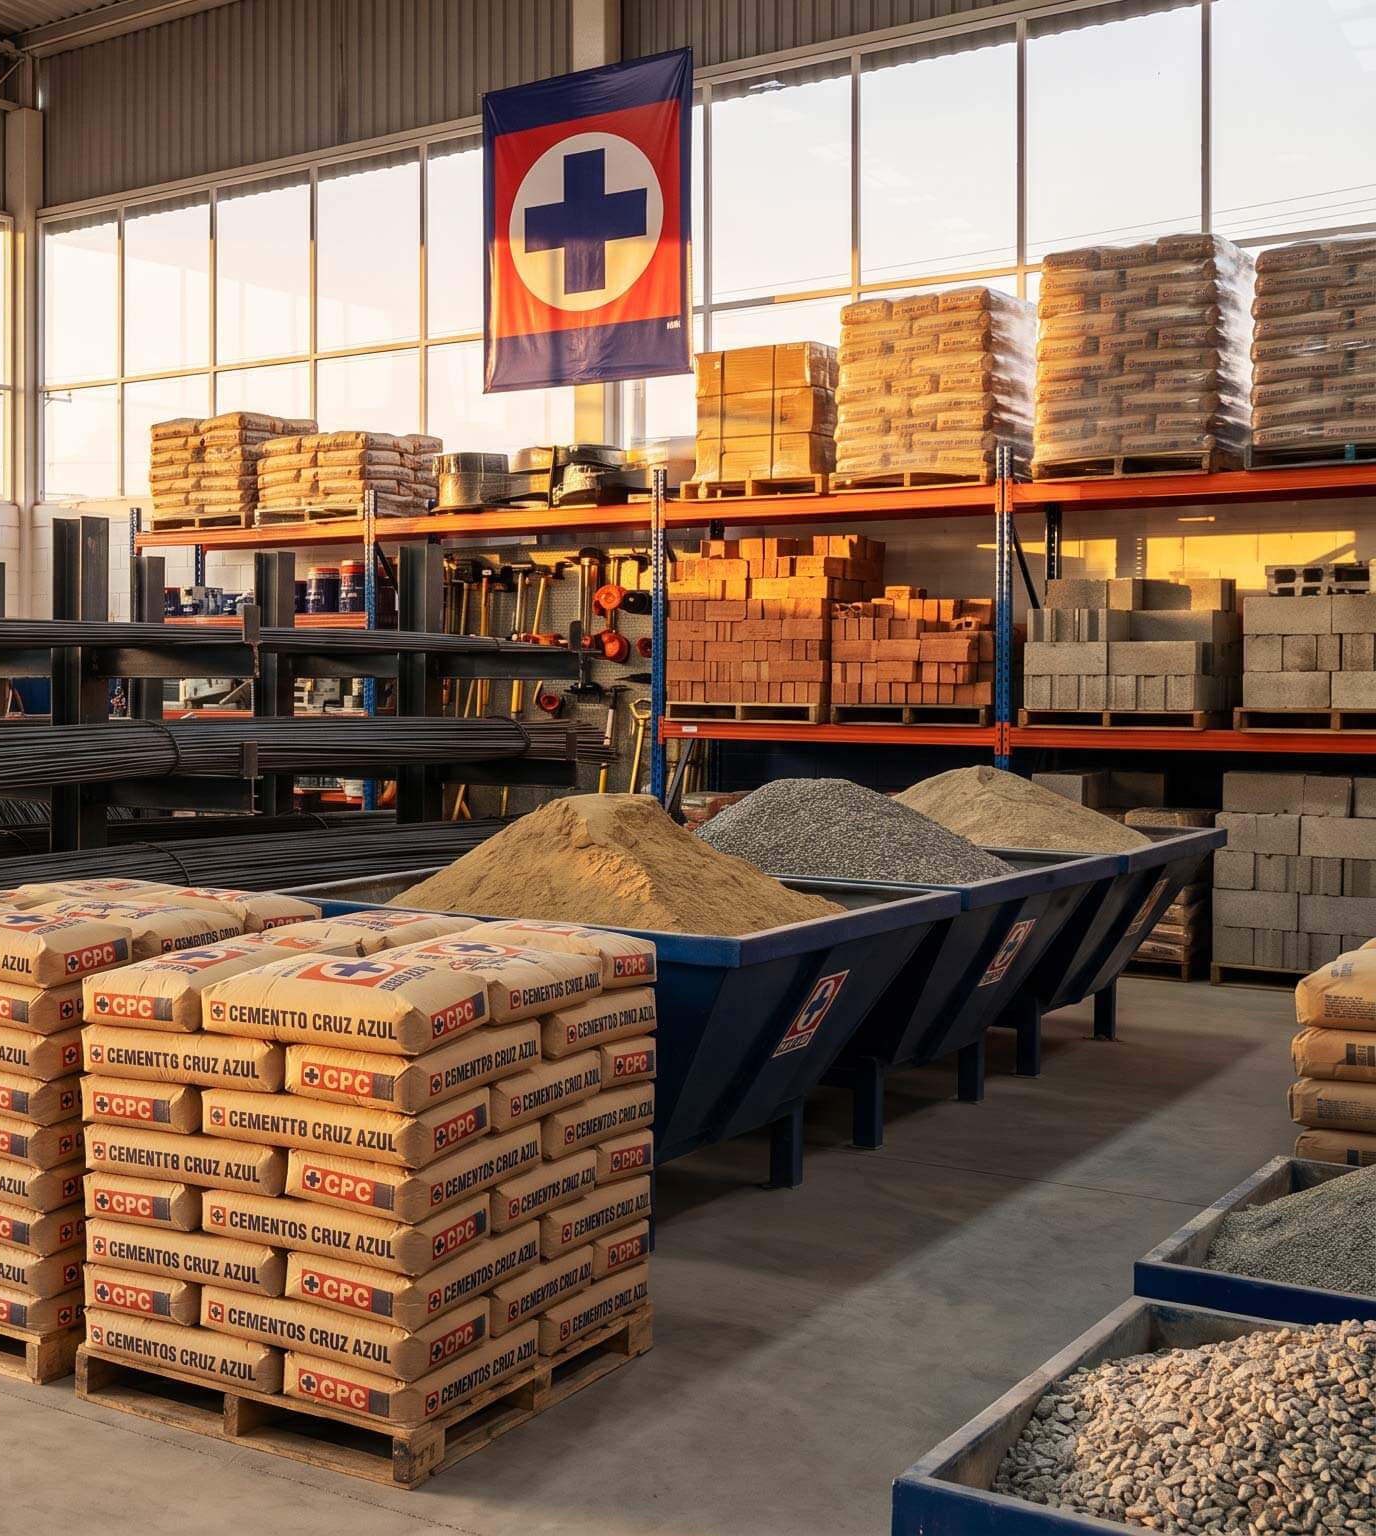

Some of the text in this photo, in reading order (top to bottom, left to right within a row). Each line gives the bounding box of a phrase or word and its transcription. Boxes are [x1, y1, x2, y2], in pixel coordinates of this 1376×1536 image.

[2, 955, 32, 973] AZUL
[82, 946, 114, 968] CPC
[625, 956, 646, 974] CPC
[112, 997, 153, 1017] CPC
[446, 1002, 474, 1028] CPC
[312, 1014, 352, 1034] CRUZ
[357, 1019, 397, 1040] AZUL
[183, 1054, 219, 1074] CRUZ
[222, 1059, 260, 1079] AZUL
[324, 1069, 370, 1094] CPC
[112, 1098, 151, 1118] CPC
[312, 1122, 352, 1144] CRUZ
[356, 1129, 397, 1152] AZUL
[448, 1114, 476, 1142] CPC
[184, 1155, 220, 1176] CRUZ
[224, 1162, 260, 1183] AZUL
[622, 1149, 643, 1168] CPC
[324, 1174, 371, 1202] CPC
[446, 1160, 495, 1198] CEMENTOS
[112, 1194, 151, 1216] CPC
[230, 1211, 396, 1260] CEMENTOS CRUZ AZUL
[446, 1220, 475, 1250] CPC
[110, 1241, 260, 1284] CEMENTOS CRUZ AZUL
[619, 1240, 640, 1262] CPC
[324, 1279, 369, 1308] CPC
[444, 1263, 494, 1304] CEMENTOS
[112, 1287, 151, 1310] CPC
[228, 1308, 392, 1364] CEMENTOS CRUZ AZUL
[444, 1326, 473, 1356] CPC
[180, 1348, 216, 1372] CRUZ
[220, 1358, 256, 1382] AZUL
[320, 1380, 366, 1408] CPC
[441, 1363, 490, 1405] CEMENTOS
